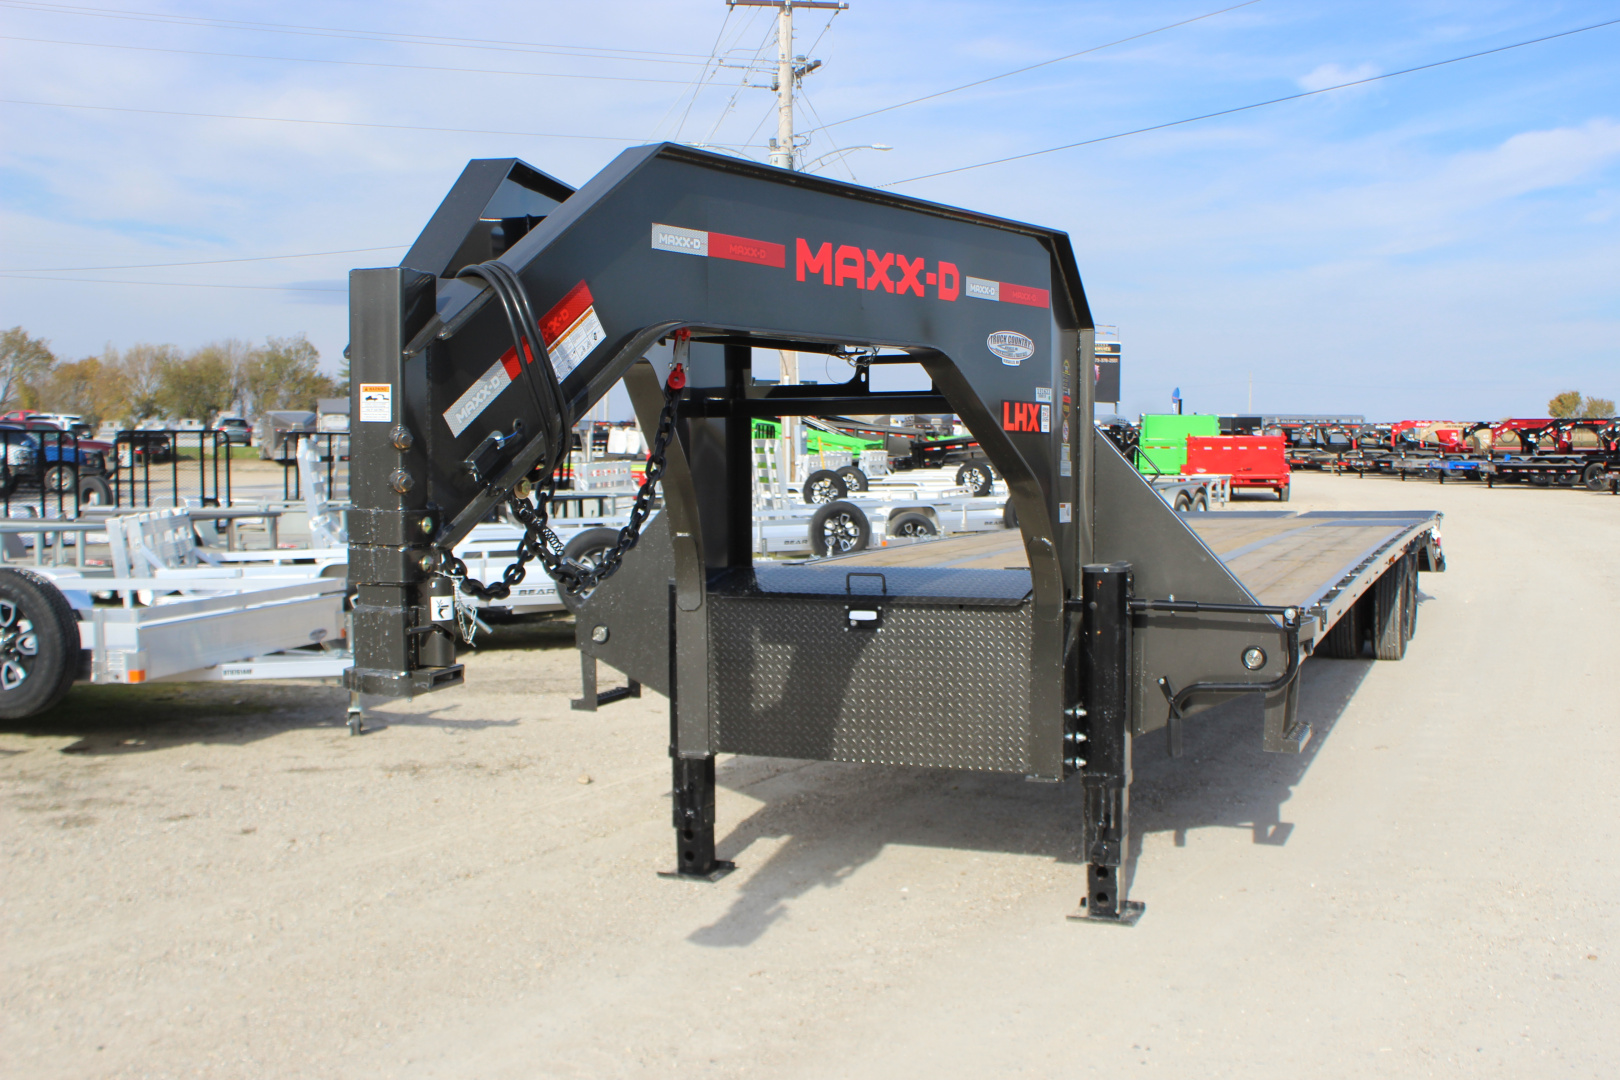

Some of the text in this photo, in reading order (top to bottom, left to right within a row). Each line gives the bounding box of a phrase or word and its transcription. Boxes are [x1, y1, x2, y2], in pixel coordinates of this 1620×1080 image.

[659, 233, 701, 250] MAXX-D
[729, 244, 766, 259] MAXX-D
[796, 237, 960, 302] MAXX-D
[969, 283, 995, 296] MAXX-D
[990, 334, 1033, 350] TRUCK COUNTRY
[455, 375, 501, 424] MAXX-D
[1003, 401, 1040, 432] LHX
[519, 588, 556, 596] BEAR
